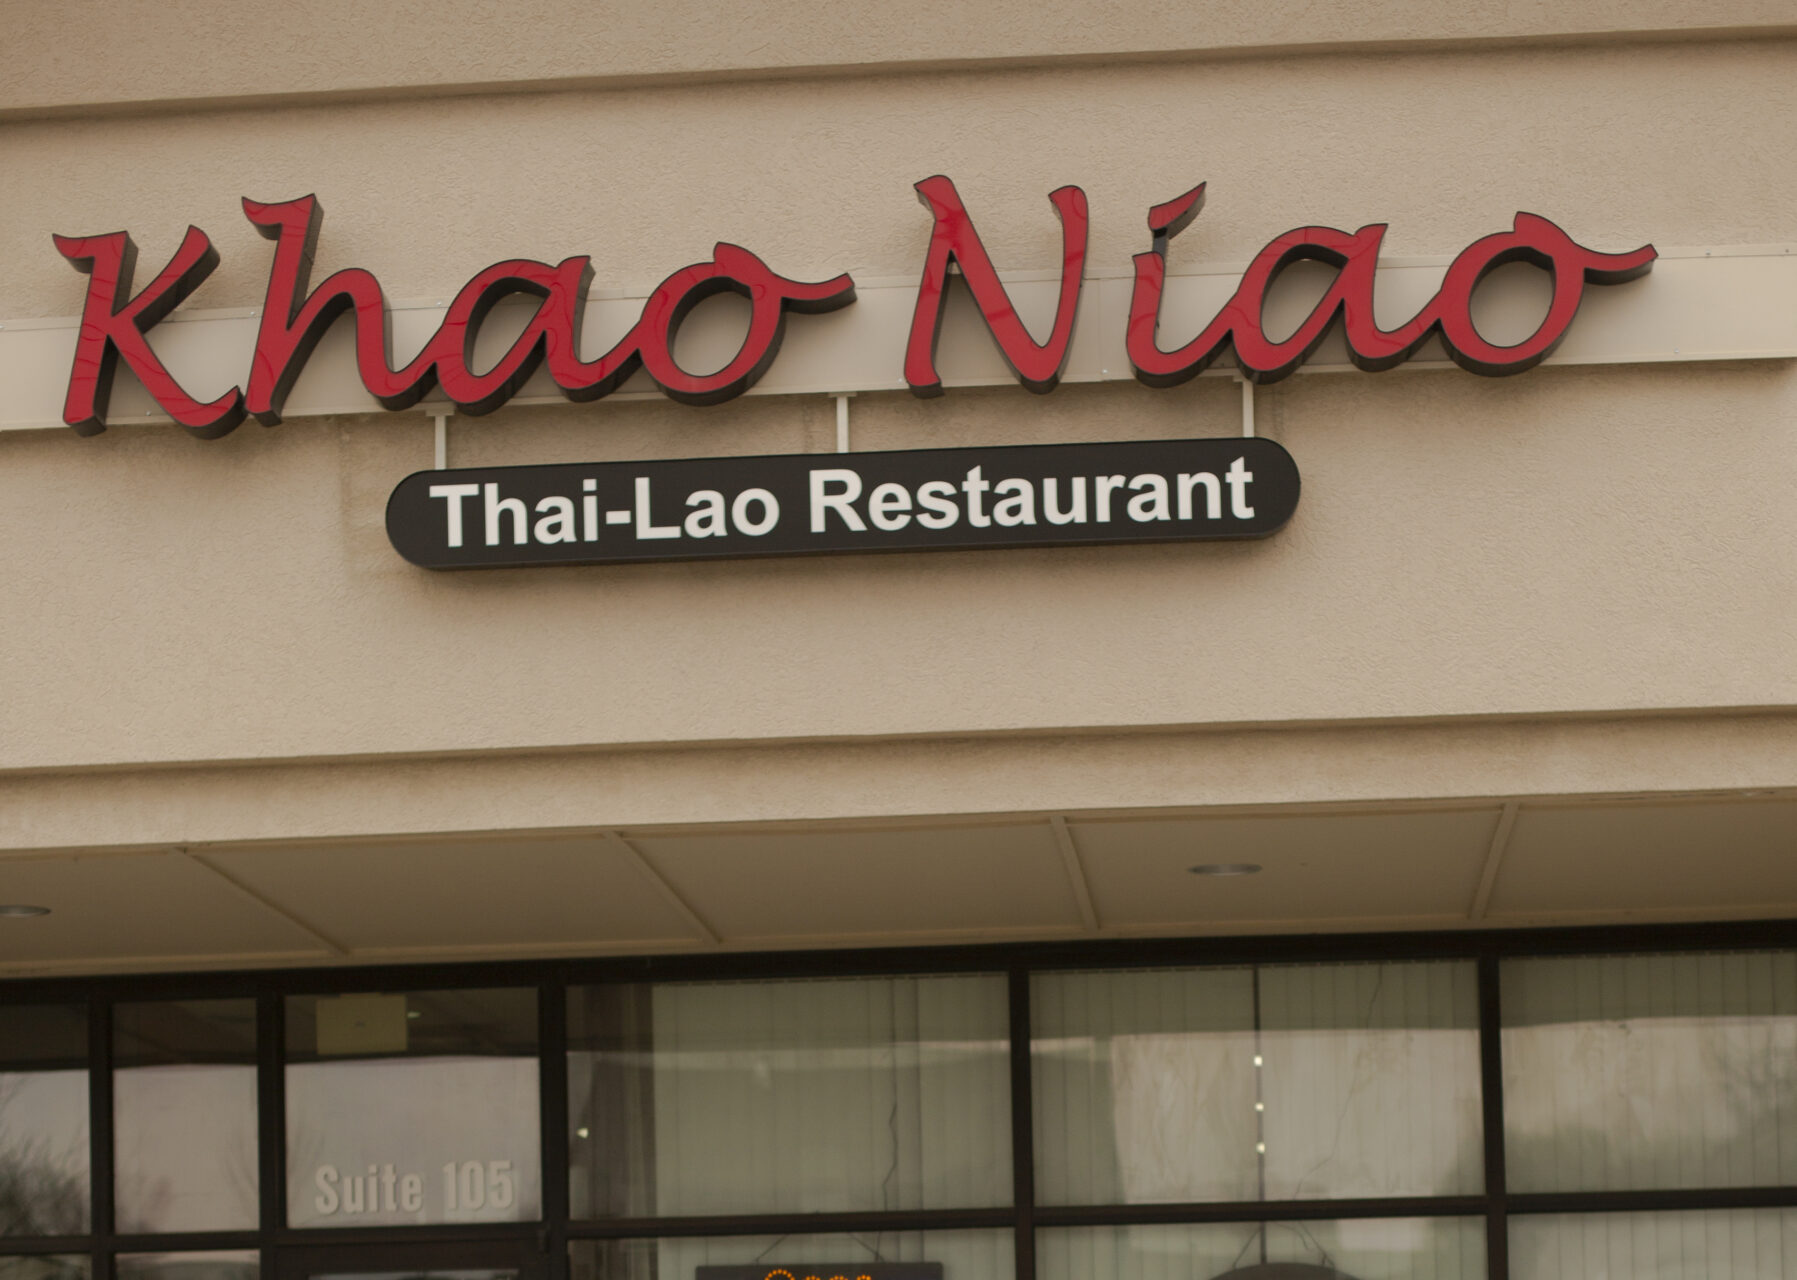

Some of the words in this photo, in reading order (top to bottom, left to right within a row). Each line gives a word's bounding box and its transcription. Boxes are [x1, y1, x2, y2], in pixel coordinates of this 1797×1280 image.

[53, 193, 858, 438] Khao
[904, 175, 1659, 398] Niao
[429, 477, 780, 547] Thai-Lao
[809, 456, 1255, 534] Restaurant
[315, 1163, 424, 1214] Suite
[442, 1160, 514, 1211] 105
